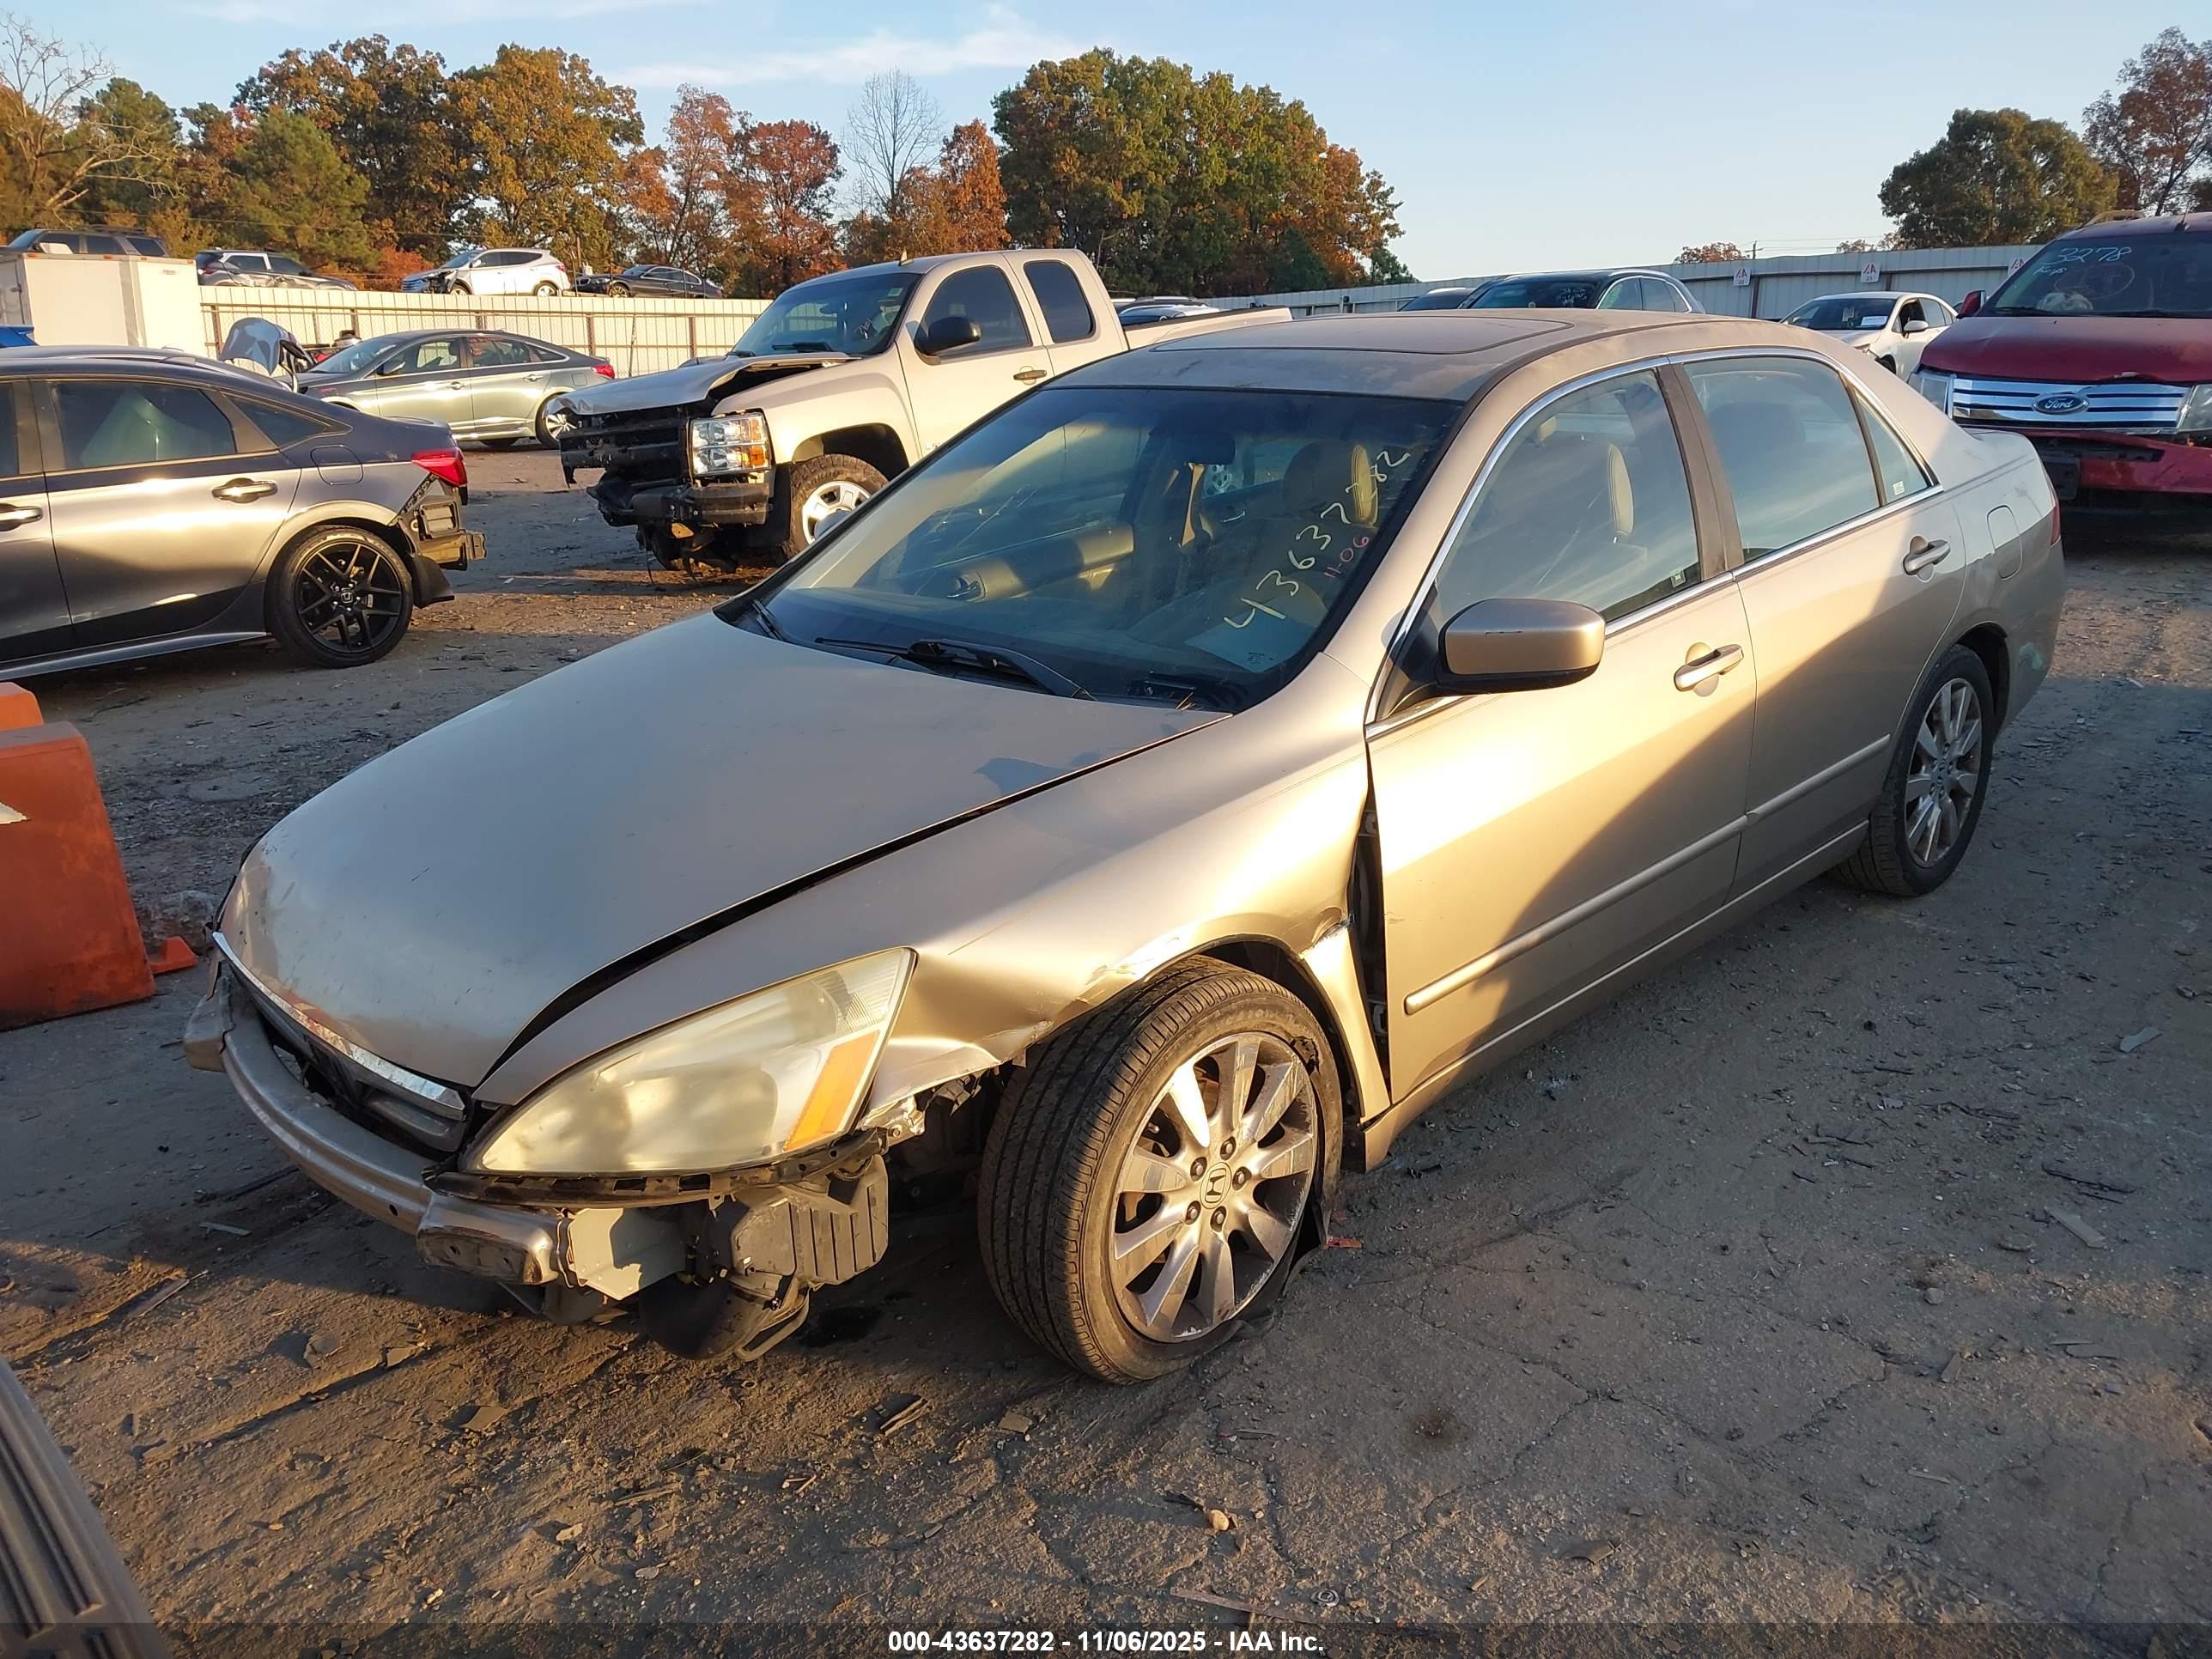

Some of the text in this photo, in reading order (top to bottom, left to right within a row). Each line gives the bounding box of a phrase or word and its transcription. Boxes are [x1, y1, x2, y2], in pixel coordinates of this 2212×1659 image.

[2041, 246, 2133, 265] 3278
[2044, 398, 2074, 409] Ford
[1322, 536, 1370, 579] 11-06
